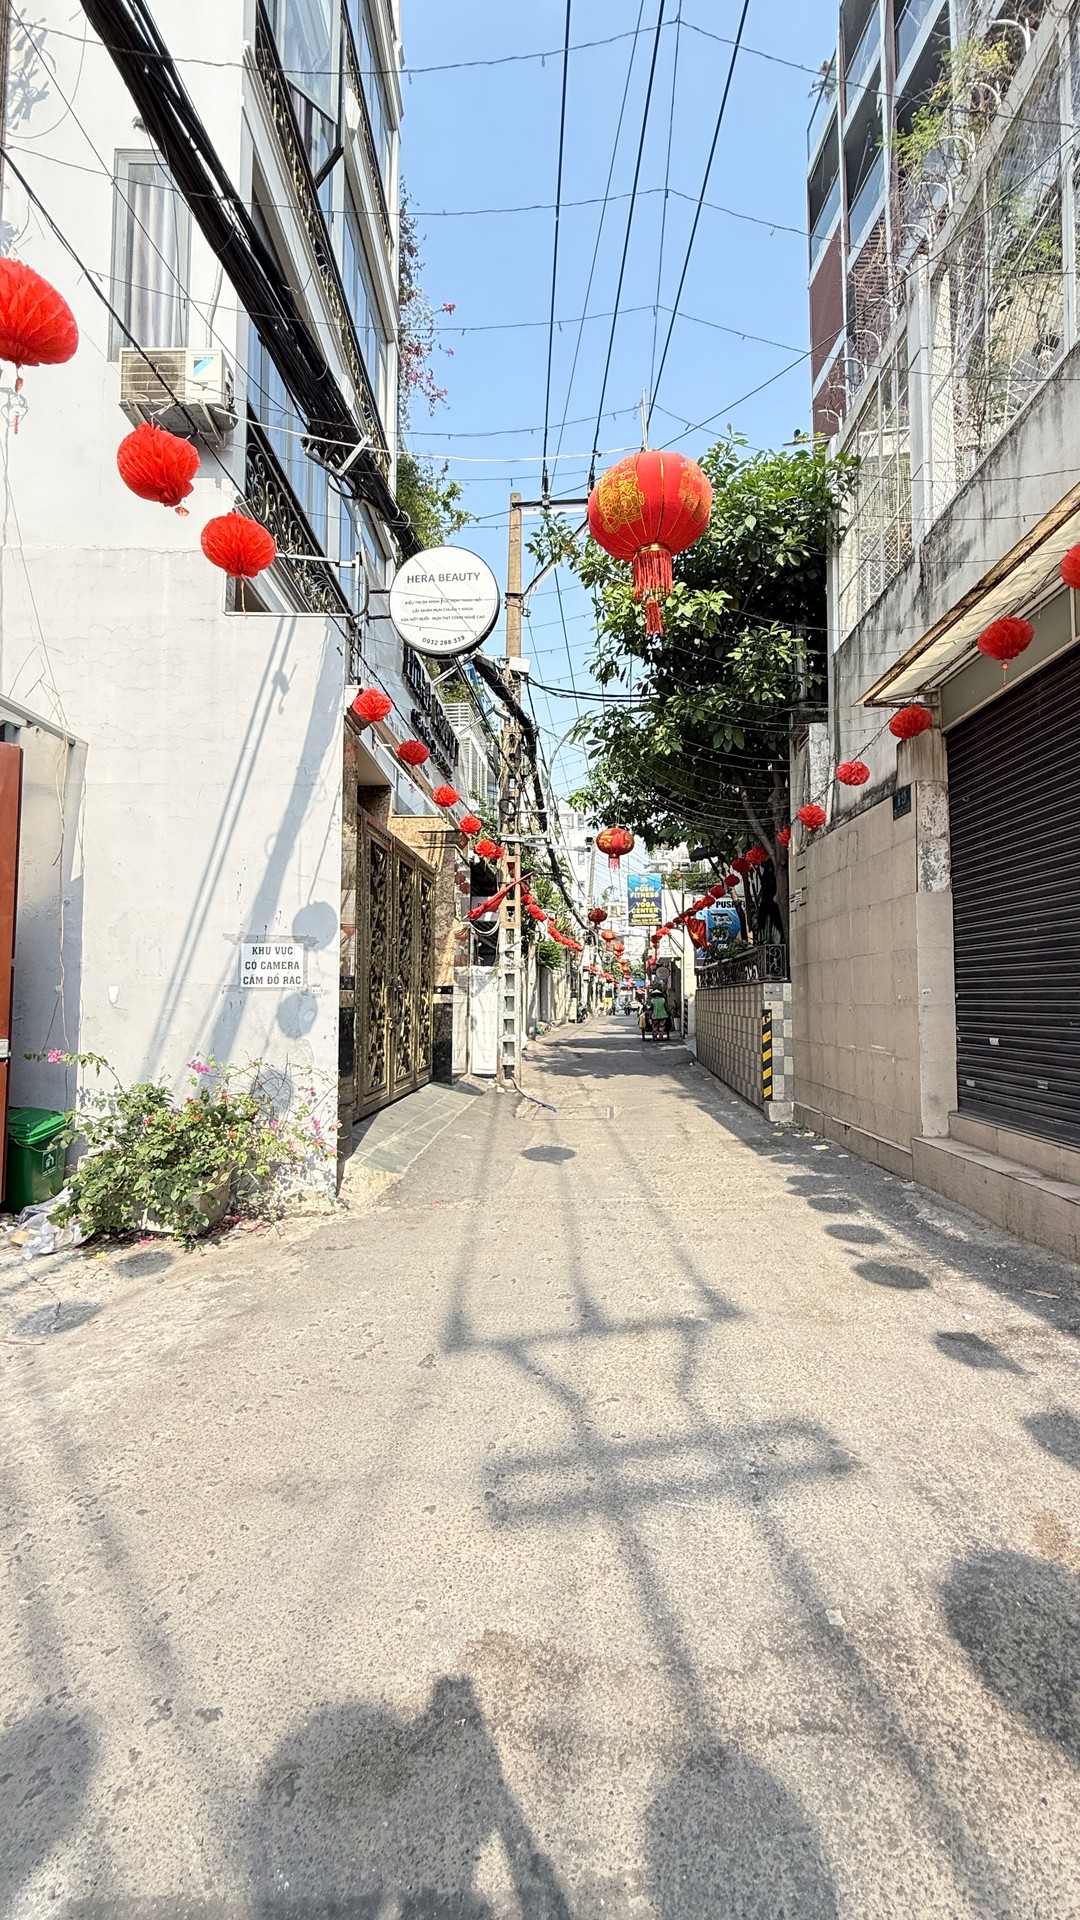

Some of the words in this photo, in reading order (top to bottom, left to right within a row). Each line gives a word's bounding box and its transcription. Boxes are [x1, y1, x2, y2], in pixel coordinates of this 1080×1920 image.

[407, 574, 436, 584] HERA
[438, 572, 481, 582] BEAUTY
[422, 637, 438, 645] 0932
[252, 946, 271, 955] KHU
[245, 959, 257, 970] CÓ
[260, 961, 300, 970] CAMERA
